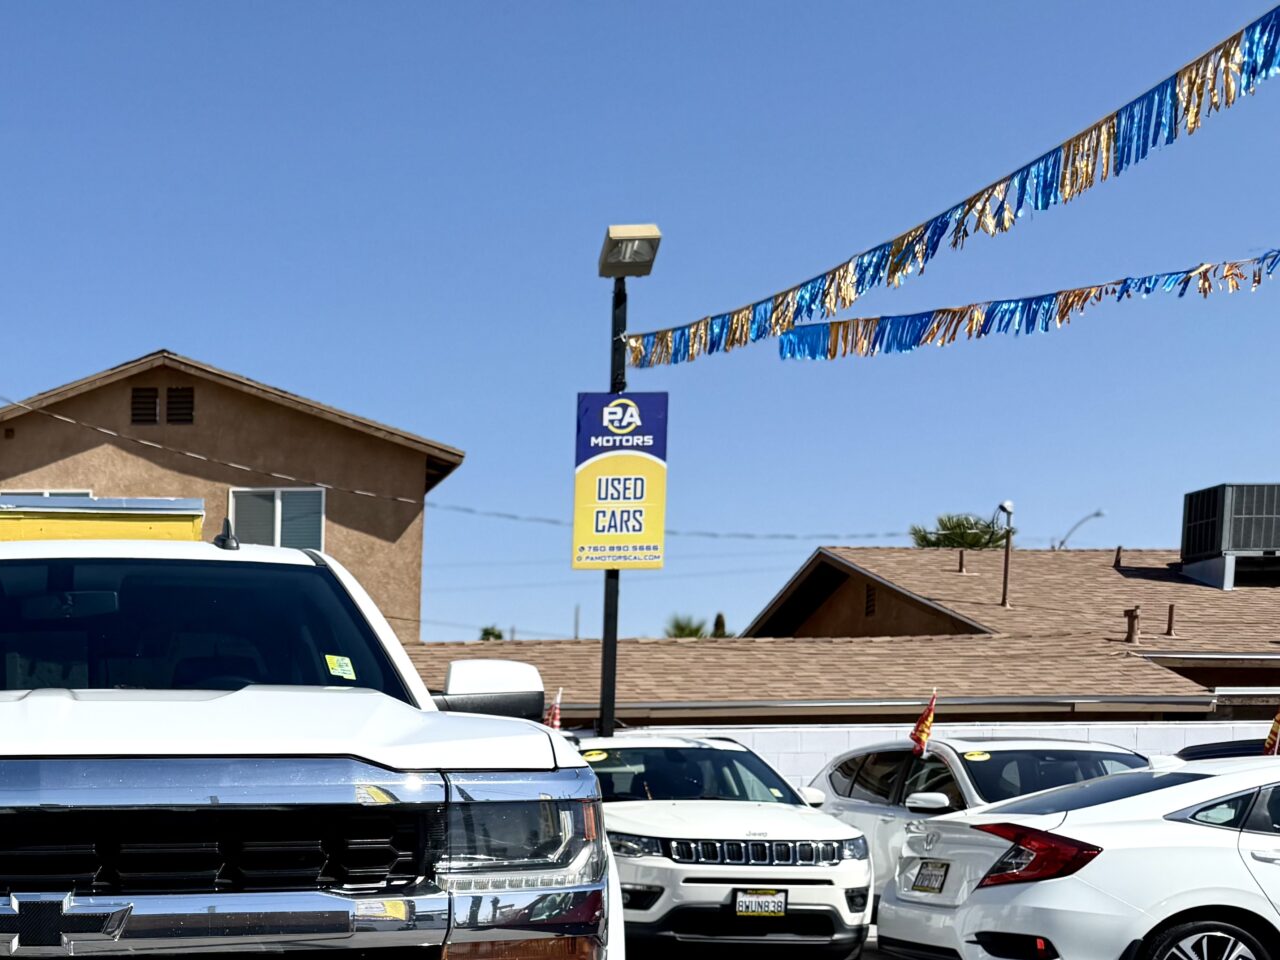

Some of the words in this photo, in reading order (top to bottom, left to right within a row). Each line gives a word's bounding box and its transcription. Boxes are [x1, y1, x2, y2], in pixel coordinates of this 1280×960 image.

[590, 435, 654, 447] MOTORS
[598, 477, 645, 501] USED
[594, 509, 643, 533] CARS
